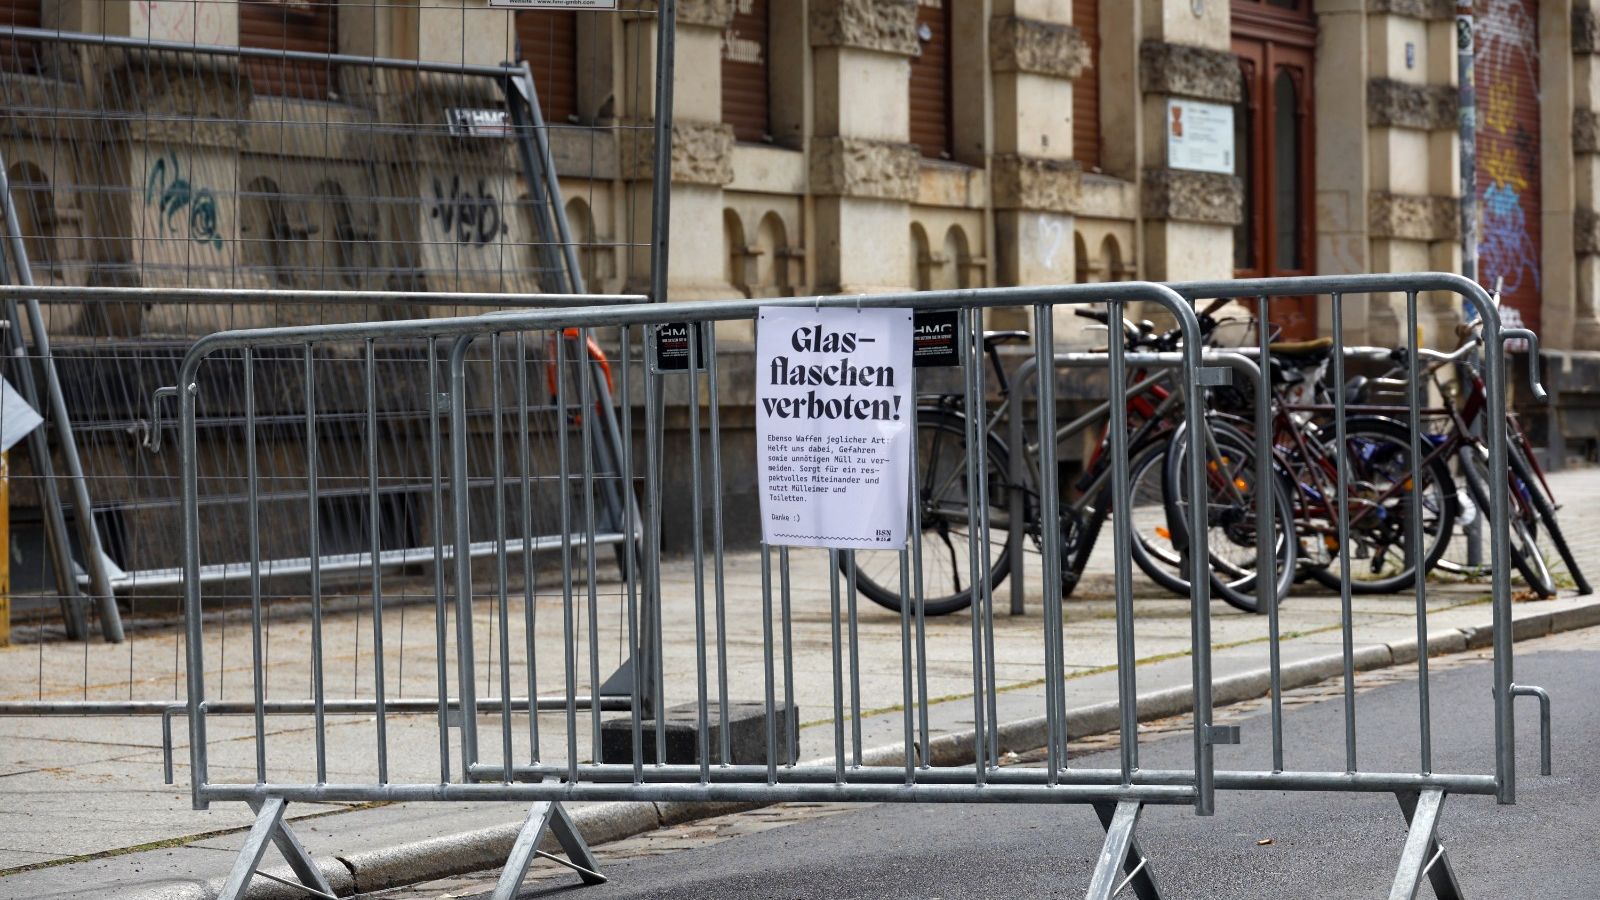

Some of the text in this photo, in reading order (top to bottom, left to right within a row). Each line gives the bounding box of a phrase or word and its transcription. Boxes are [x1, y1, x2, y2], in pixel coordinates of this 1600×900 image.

[661, 328, 688, 336] HM
[791, 324, 876, 353] Glas-
[770, 356, 895, 387] flaschen
[762, 391, 902, 421] verboten!
[767, 434, 792, 442] Ebenso
[796, 435, 822, 443] Waffen
[826, 435, 867, 445] jeglicher
[808, 446, 834, 454] dabei,
[839, 446, 876, 454] Gefahren
[791, 455, 830, 464] unnötigen
[800, 466, 821, 474] Sorgt
[812, 475, 860, 484] Miteinander
[791, 485, 829, 493] Mülleimer
[770, 494, 807, 502] Toiletten.
